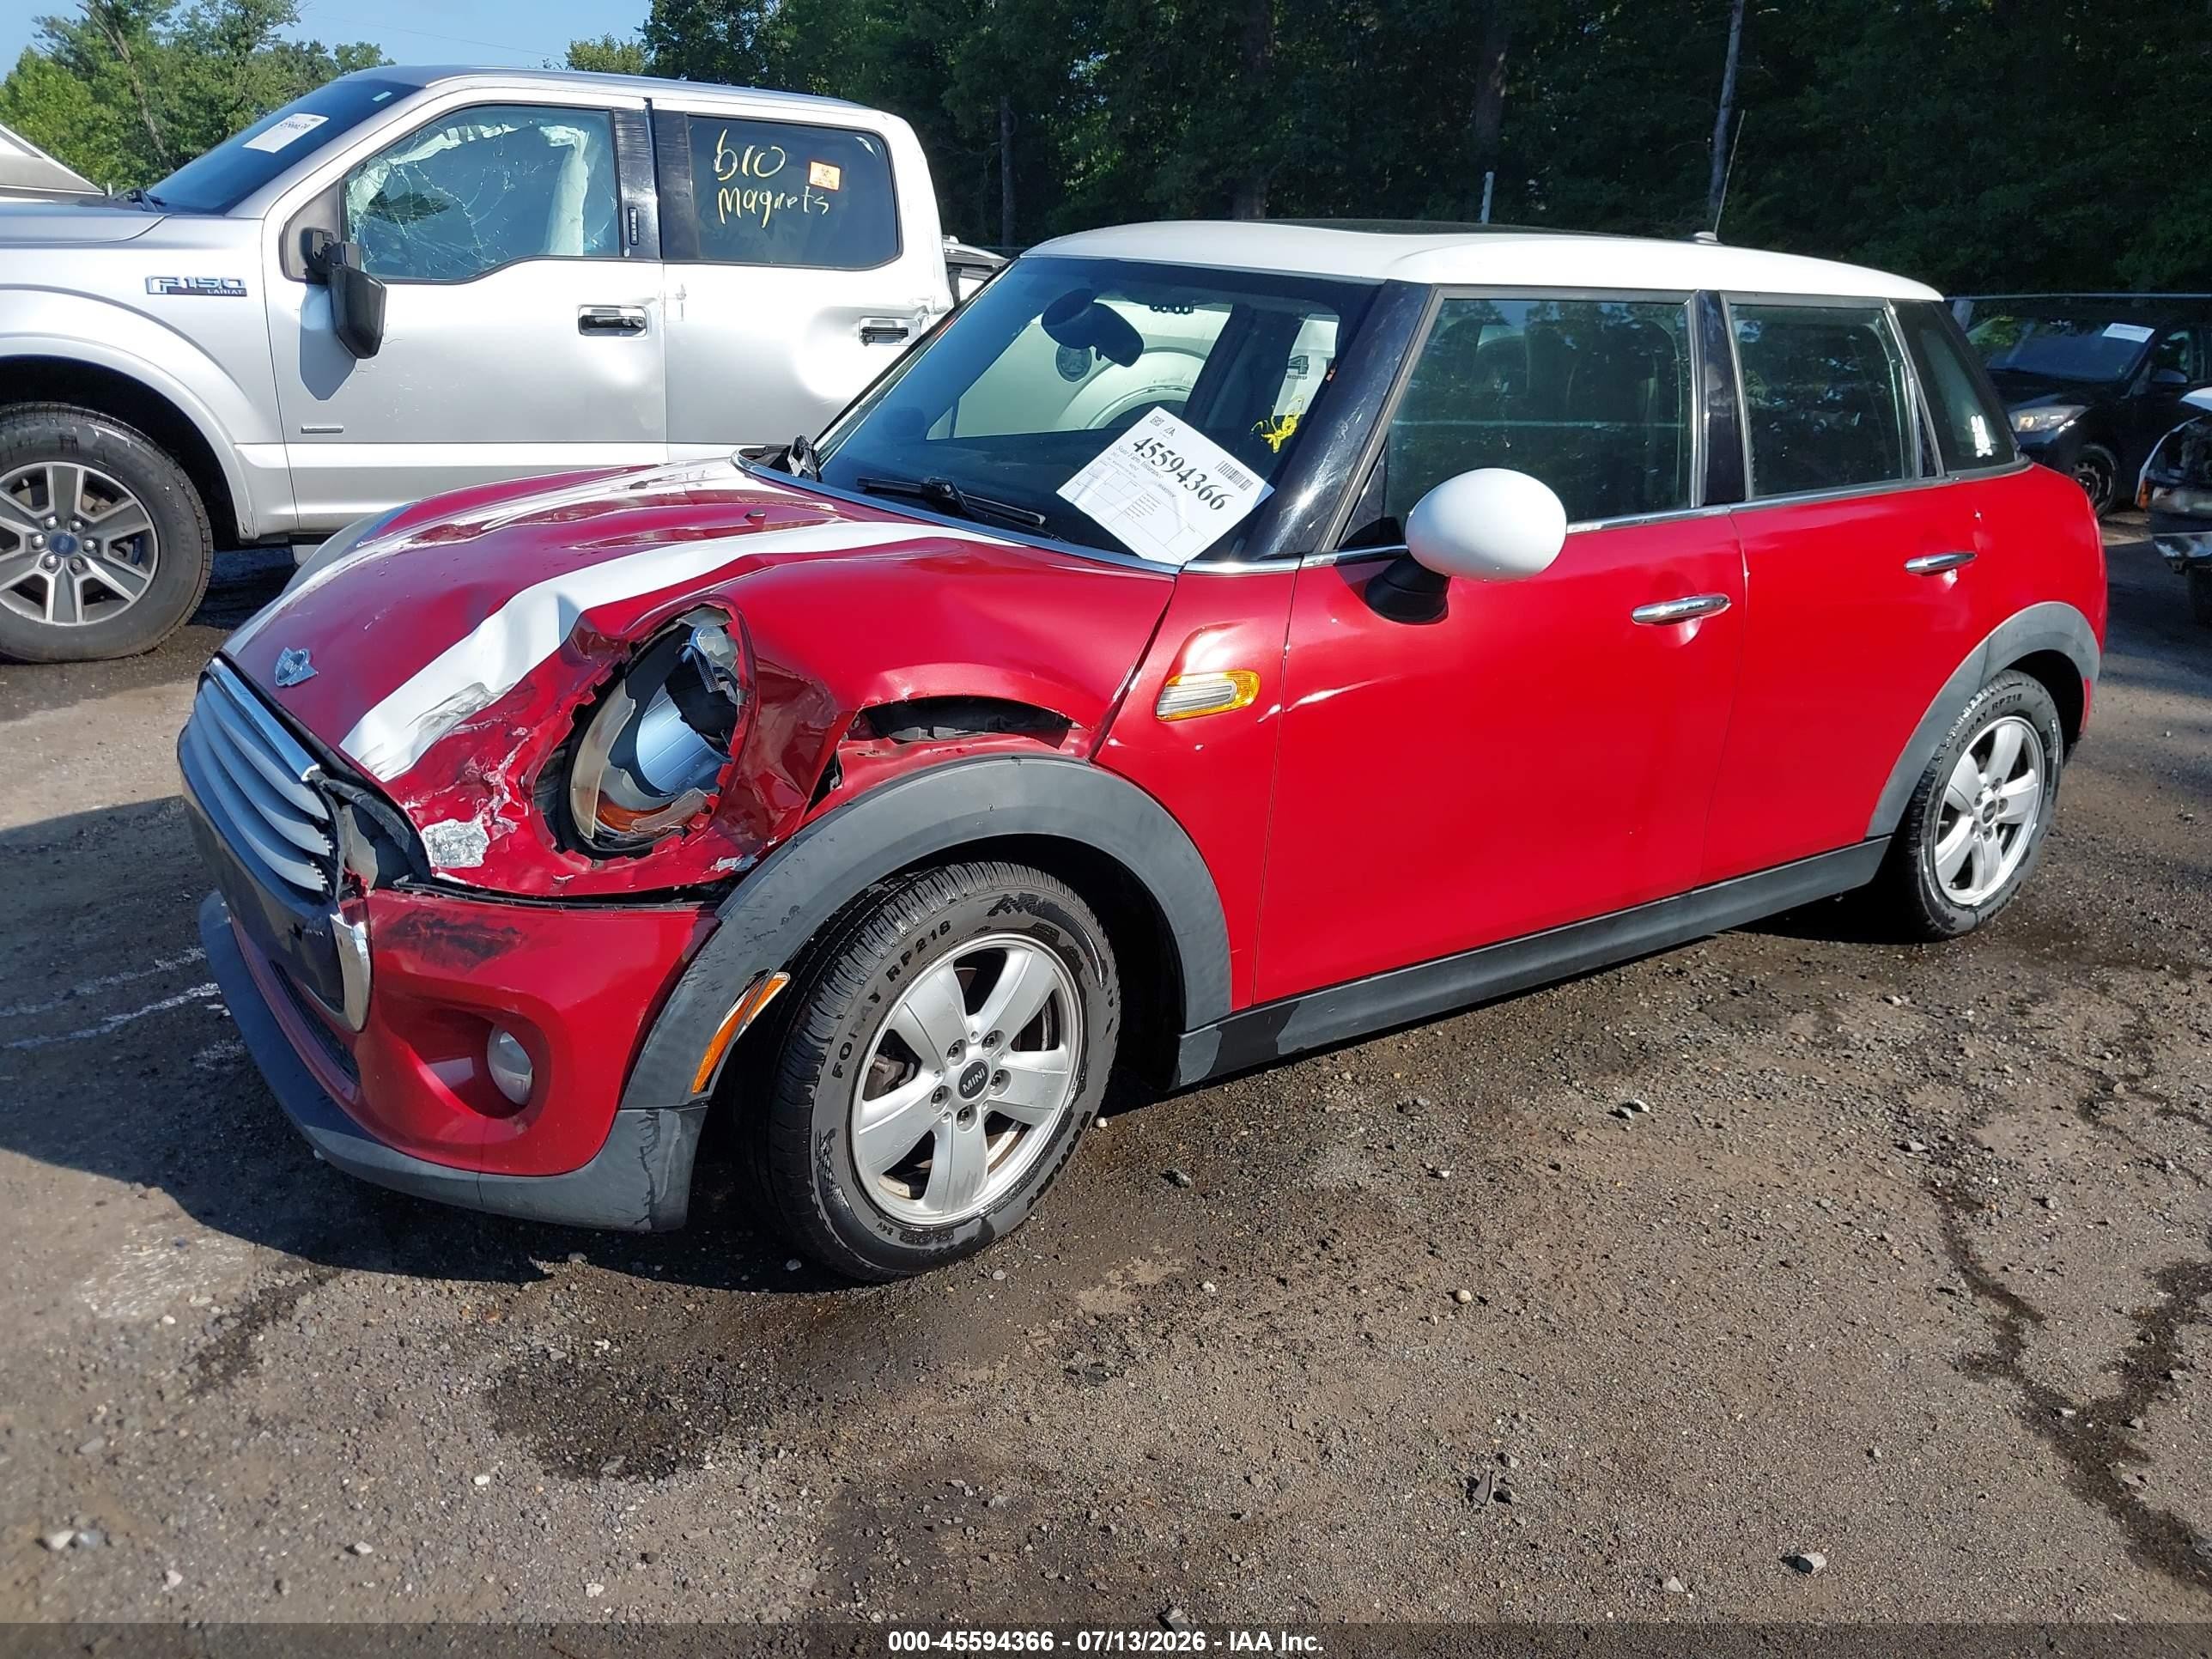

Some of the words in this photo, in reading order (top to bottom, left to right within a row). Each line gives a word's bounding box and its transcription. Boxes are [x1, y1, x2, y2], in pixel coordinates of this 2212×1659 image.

[1133, 437, 1235, 510] 45594366
[1991, 693, 2023, 712] RP218
[885, 920, 952, 984] RP218
[962, 1067, 987, 1093] MINI
